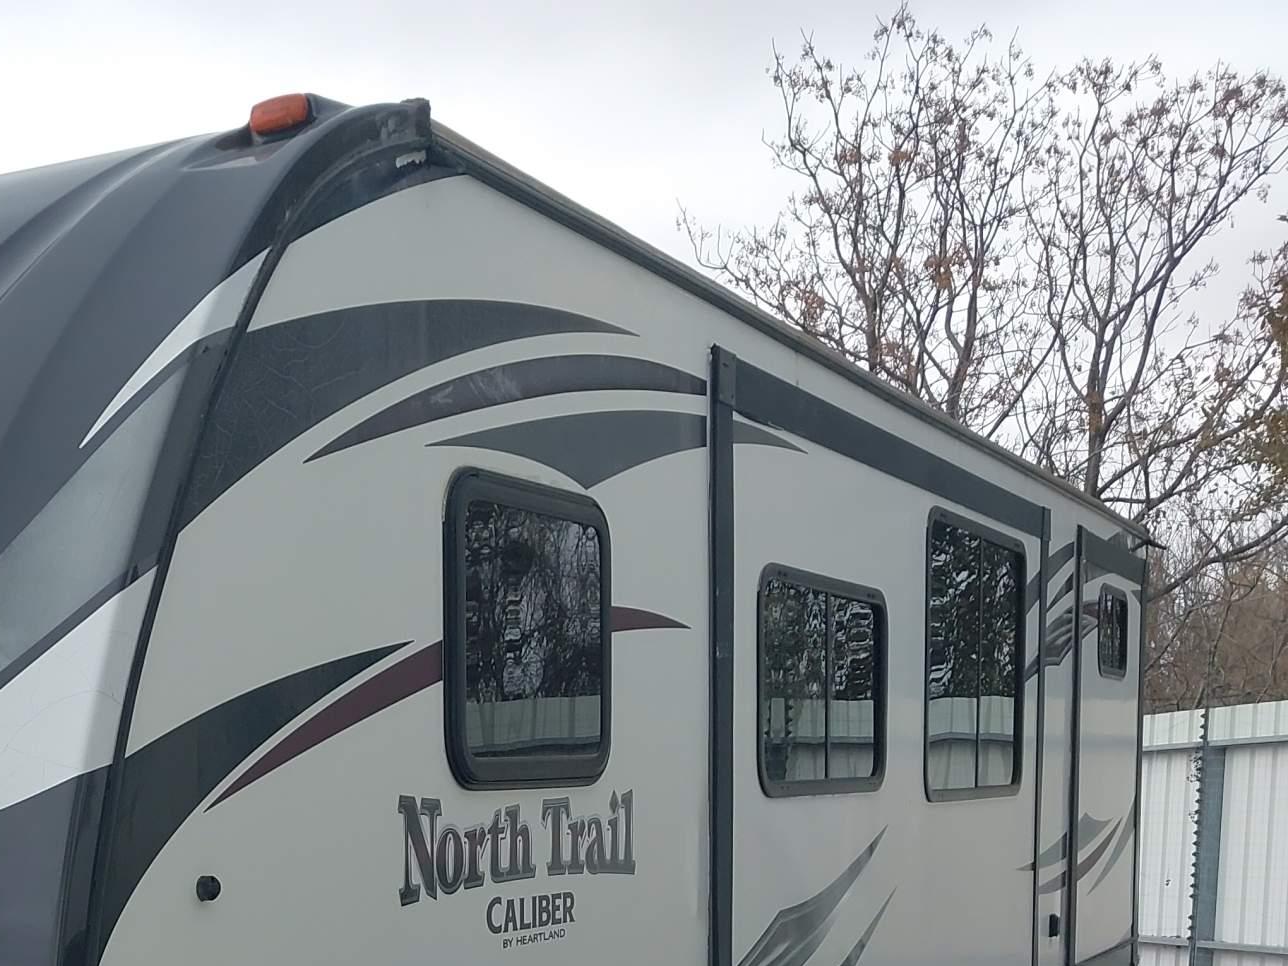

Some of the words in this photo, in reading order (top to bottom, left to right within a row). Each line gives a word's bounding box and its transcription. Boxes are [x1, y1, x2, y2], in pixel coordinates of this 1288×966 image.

[397, 794, 536, 907] North
[541, 788, 637, 877] Trail
[486, 891, 576, 935] CALIBER
[502, 938, 514, 949] BY
[516, 928, 566, 948] HEARTLAND
